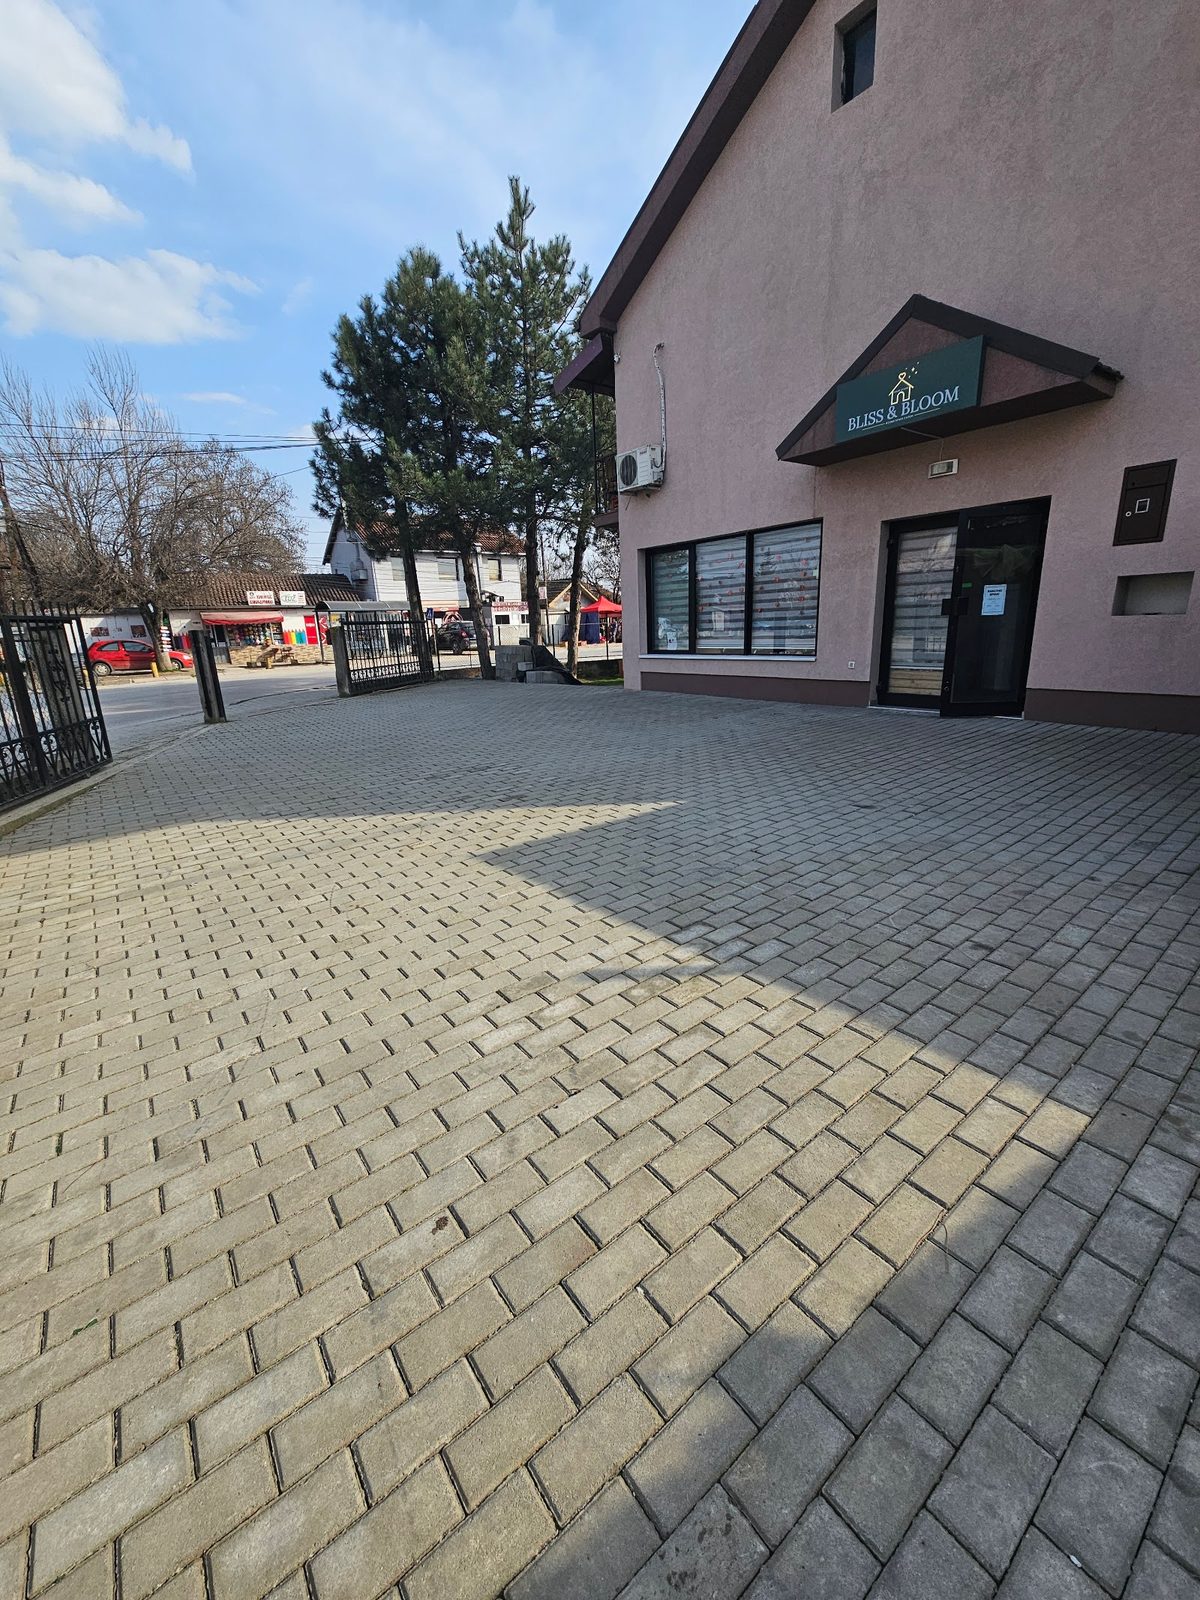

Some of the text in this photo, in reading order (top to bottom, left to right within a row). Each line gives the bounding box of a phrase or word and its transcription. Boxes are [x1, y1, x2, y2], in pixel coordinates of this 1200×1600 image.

[848, 386, 960, 431] BLISS & BLOOM
